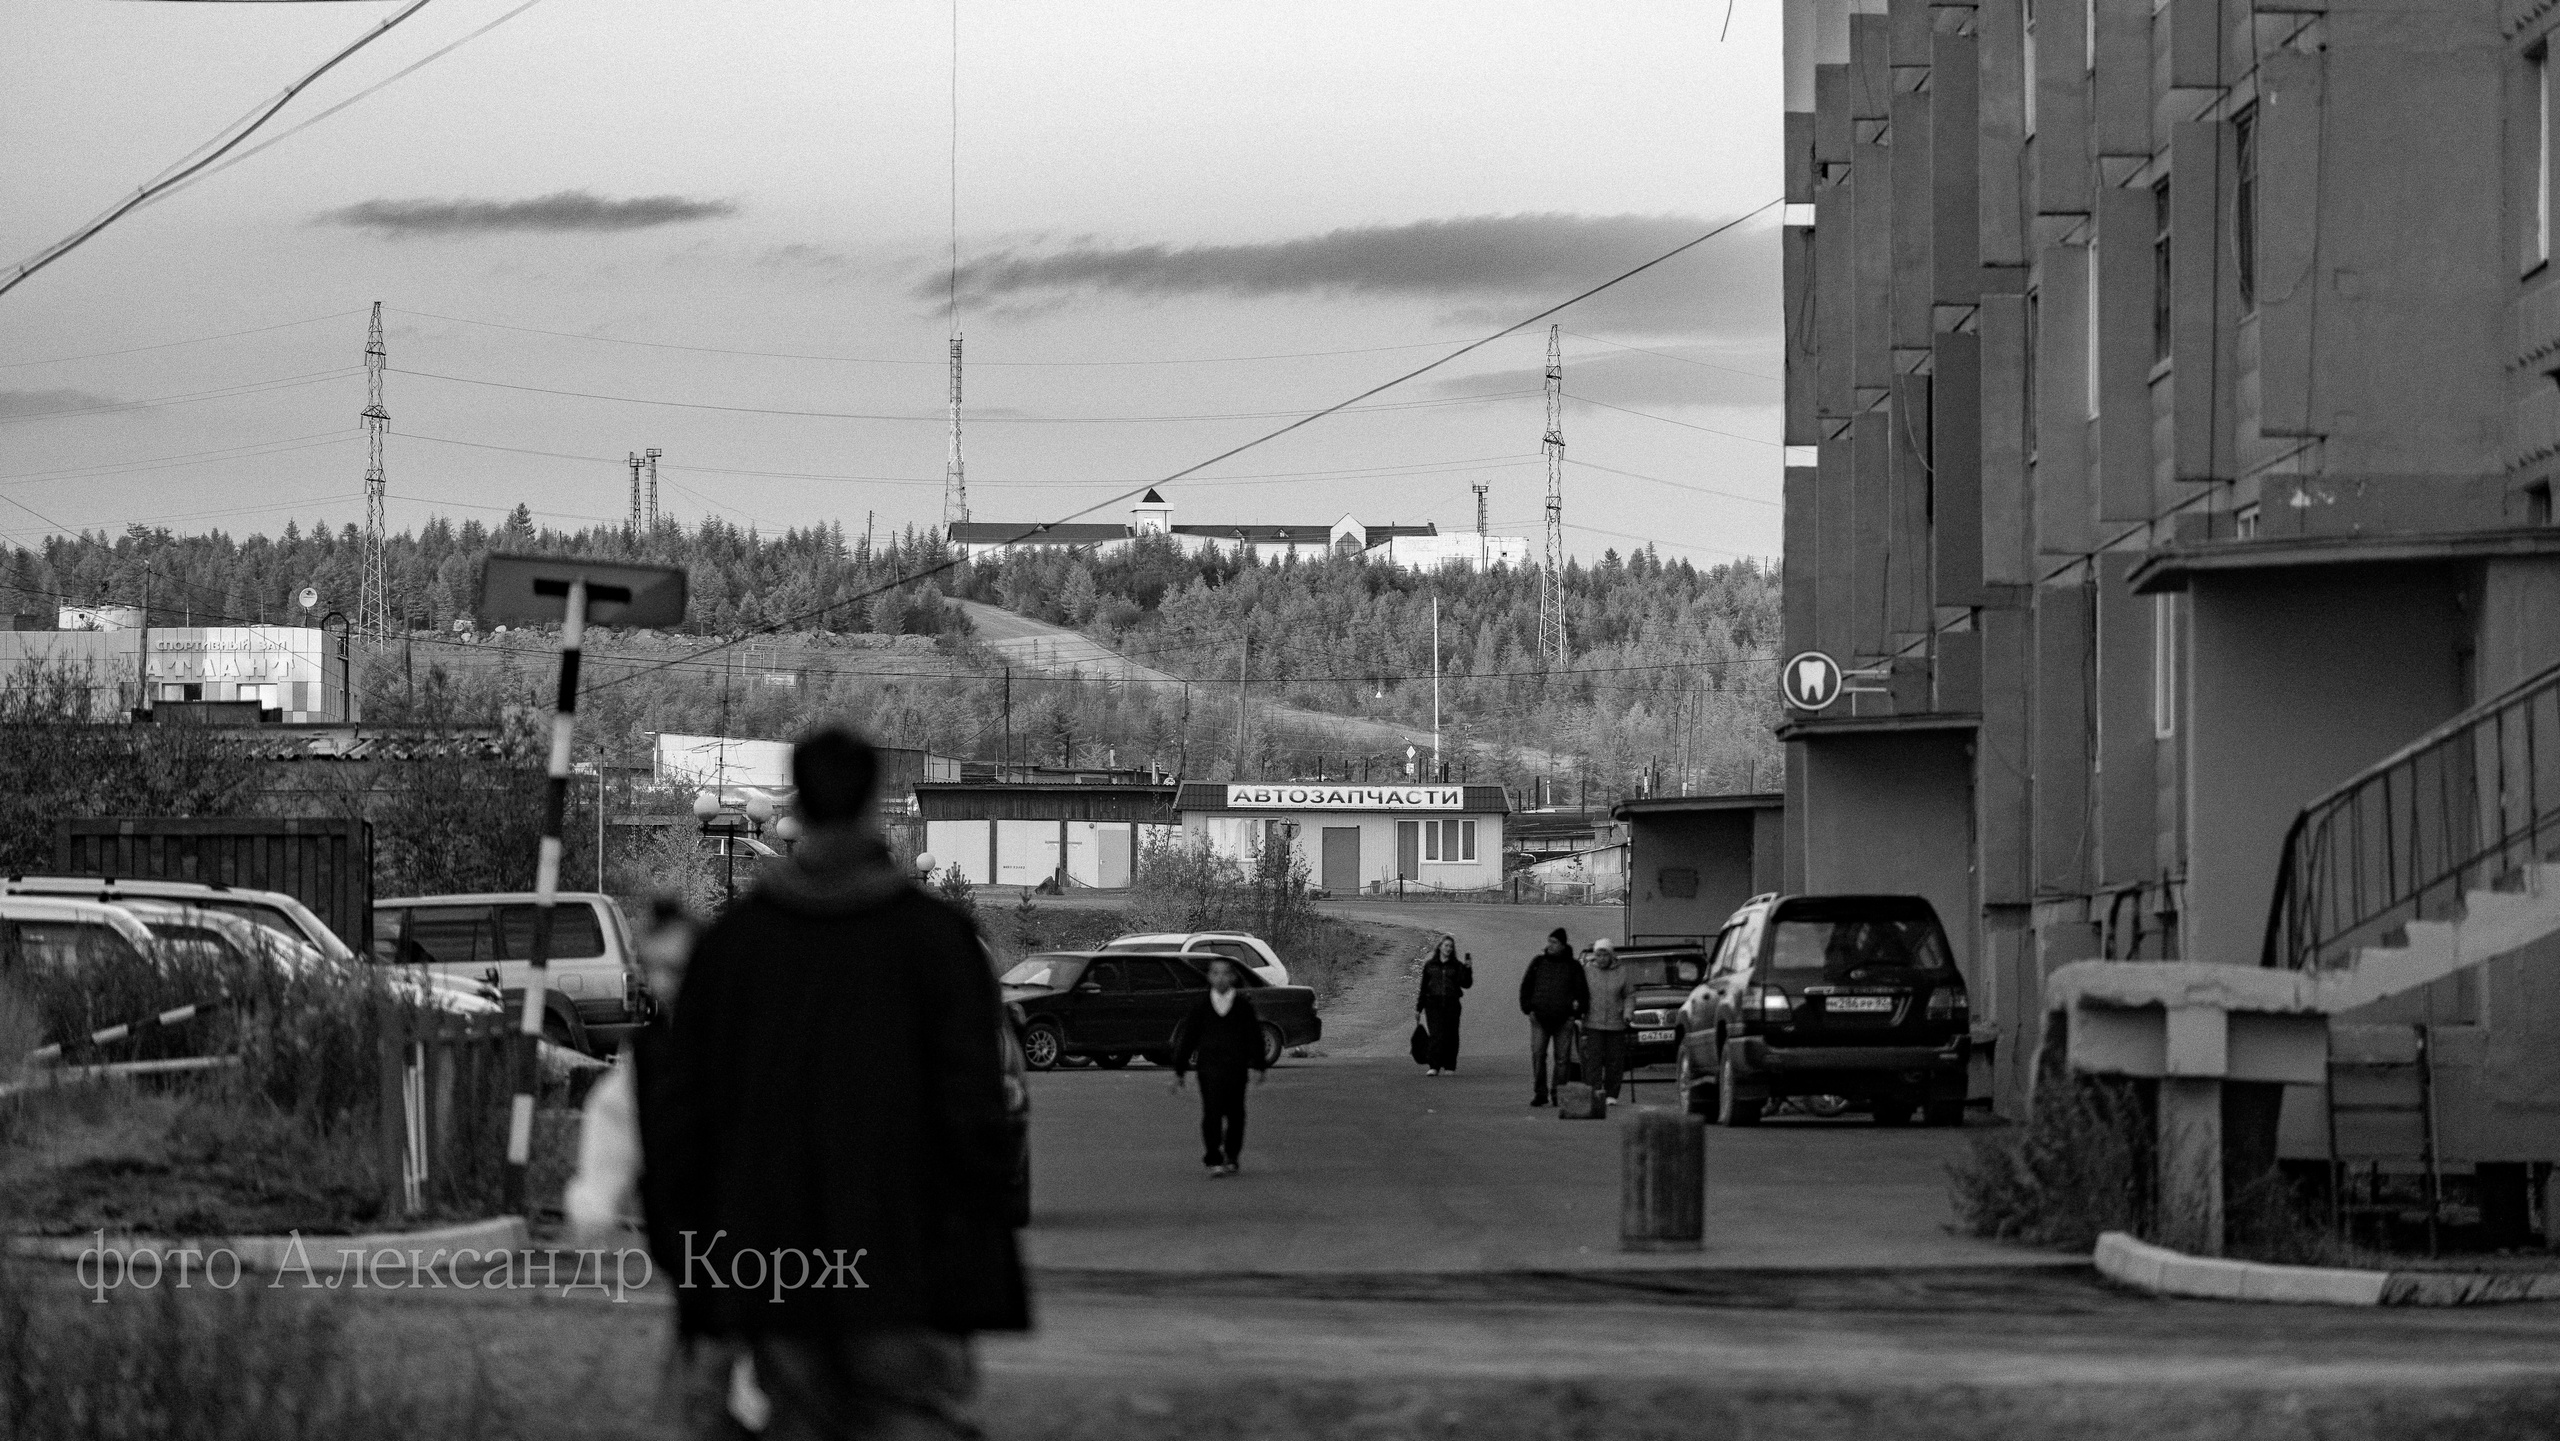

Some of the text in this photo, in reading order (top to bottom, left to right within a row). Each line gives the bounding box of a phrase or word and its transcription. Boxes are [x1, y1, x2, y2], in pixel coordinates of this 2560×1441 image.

[156, 639, 287, 651] СПОРТИВНЫЙ ЗАЛ
[146, 658, 295, 678] АТЛАНТ
[1233, 787, 1459, 805] АВТОЗАПЧАСТИ
